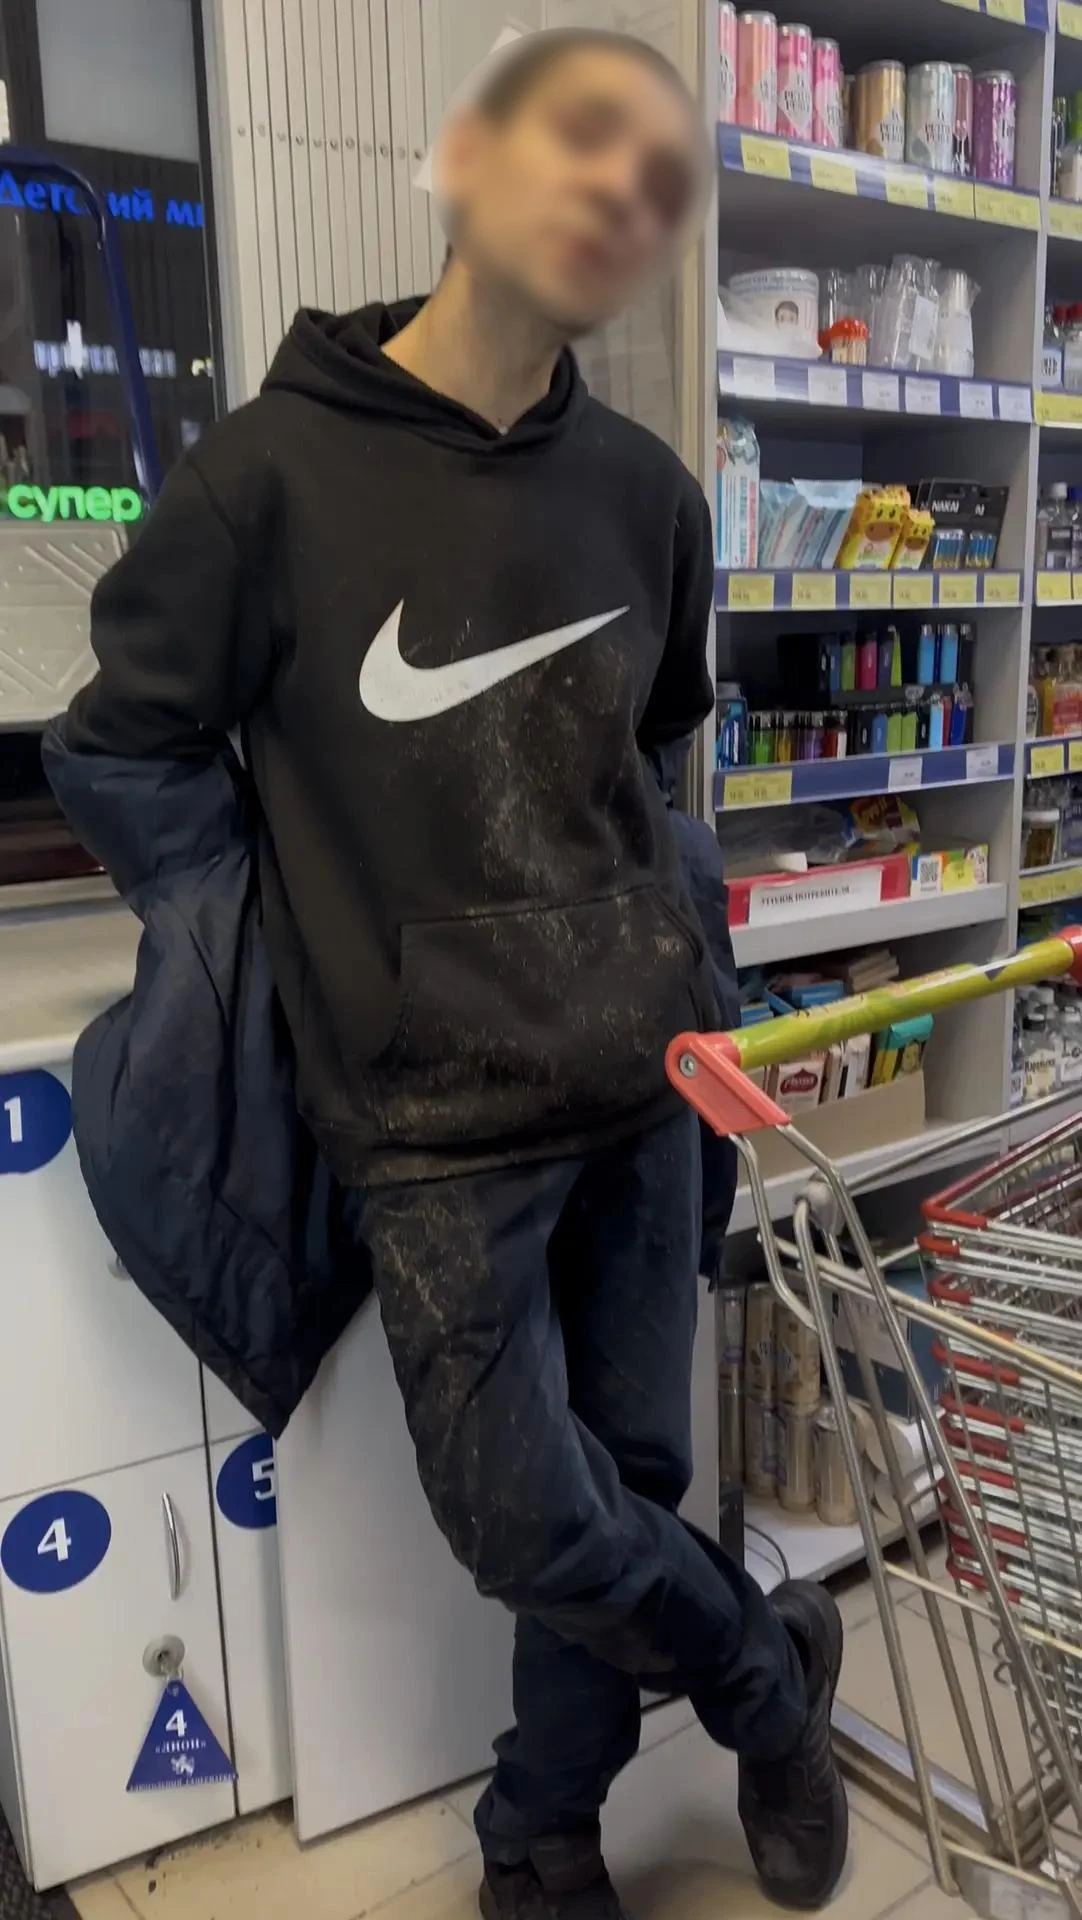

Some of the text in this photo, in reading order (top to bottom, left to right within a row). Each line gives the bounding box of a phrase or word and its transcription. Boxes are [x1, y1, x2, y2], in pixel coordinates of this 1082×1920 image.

[0, 169, 154, 223] Детсий
[7, 484, 142, 523] супер
[4, 1096, 23, 1143] 1
[252, 1457, 275, 1501] 5
[37, 1517, 72, 1562] 4
[165, 1709, 187, 1737] 4
